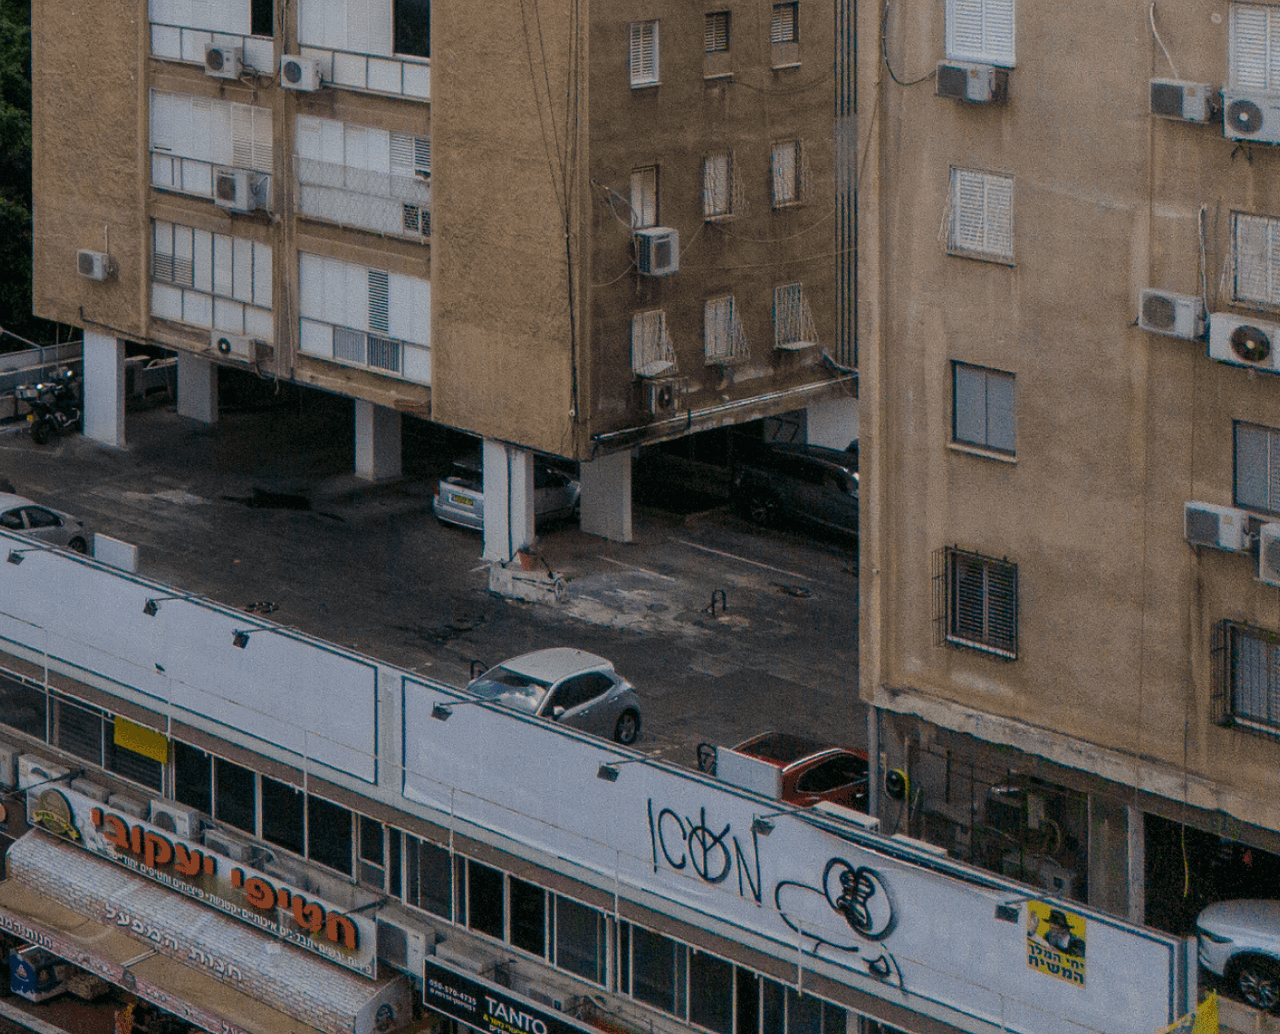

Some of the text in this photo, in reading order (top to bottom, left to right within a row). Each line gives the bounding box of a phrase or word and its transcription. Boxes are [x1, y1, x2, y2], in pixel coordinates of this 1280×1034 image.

[90, 807, 358, 952] חטיפי יעקובי
[647, 797, 762, 907] ICON
[105, 903, 242, 981] חנות המפעל
[1028, 944, 1061, 963] המלך
[1028, 954, 1084, 984] המשיח
[484, 995, 548, 1034] TANTO
